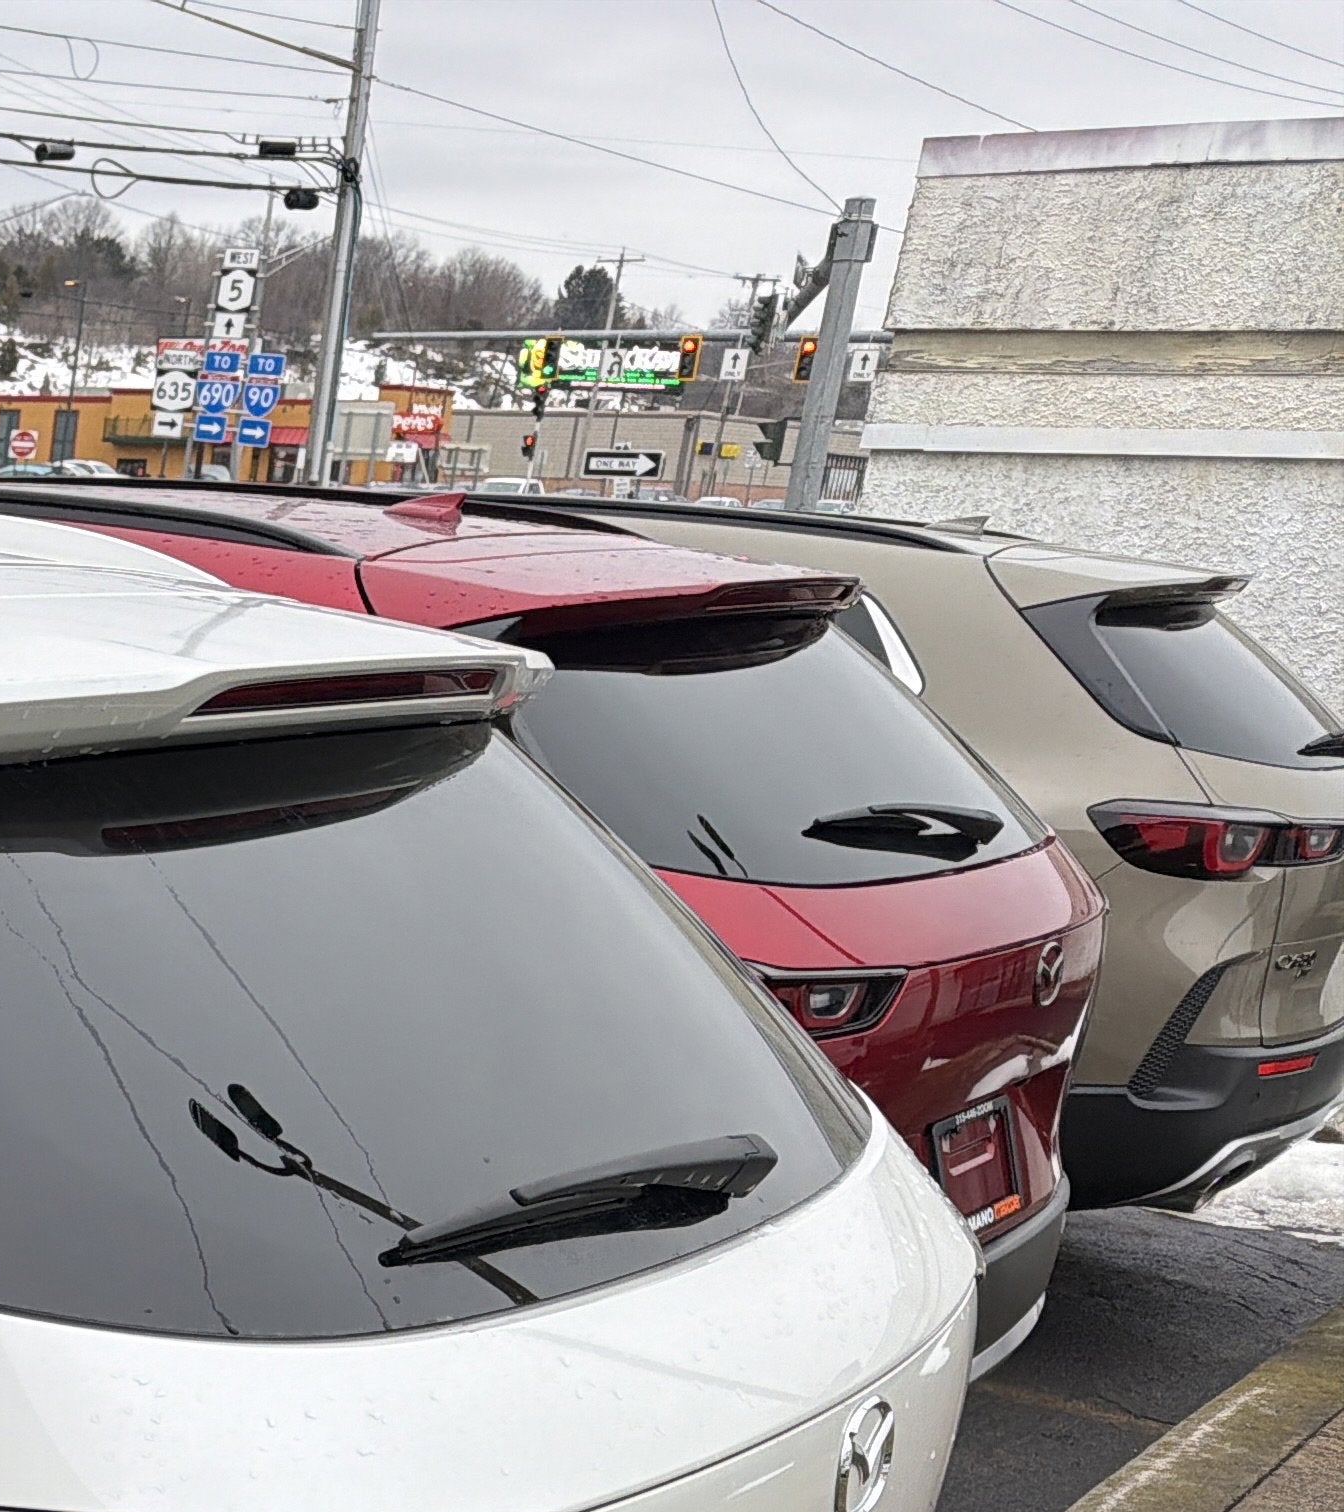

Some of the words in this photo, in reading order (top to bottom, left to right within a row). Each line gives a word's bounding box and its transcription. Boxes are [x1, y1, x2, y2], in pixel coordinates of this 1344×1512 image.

[228, 252, 256, 265] WEST
[228, 279, 244, 302] 5
[213, 355, 232, 370] TO
[257, 358, 275, 372] TO
[724, 370, 741, 378] ONLY
[853, 371, 872, 379] ONLY
[156, 380, 193, 402] 635
[199, 382, 234, 408] 690
[248, 386, 274, 408] 90
[595, 459, 614, 469] ONE
